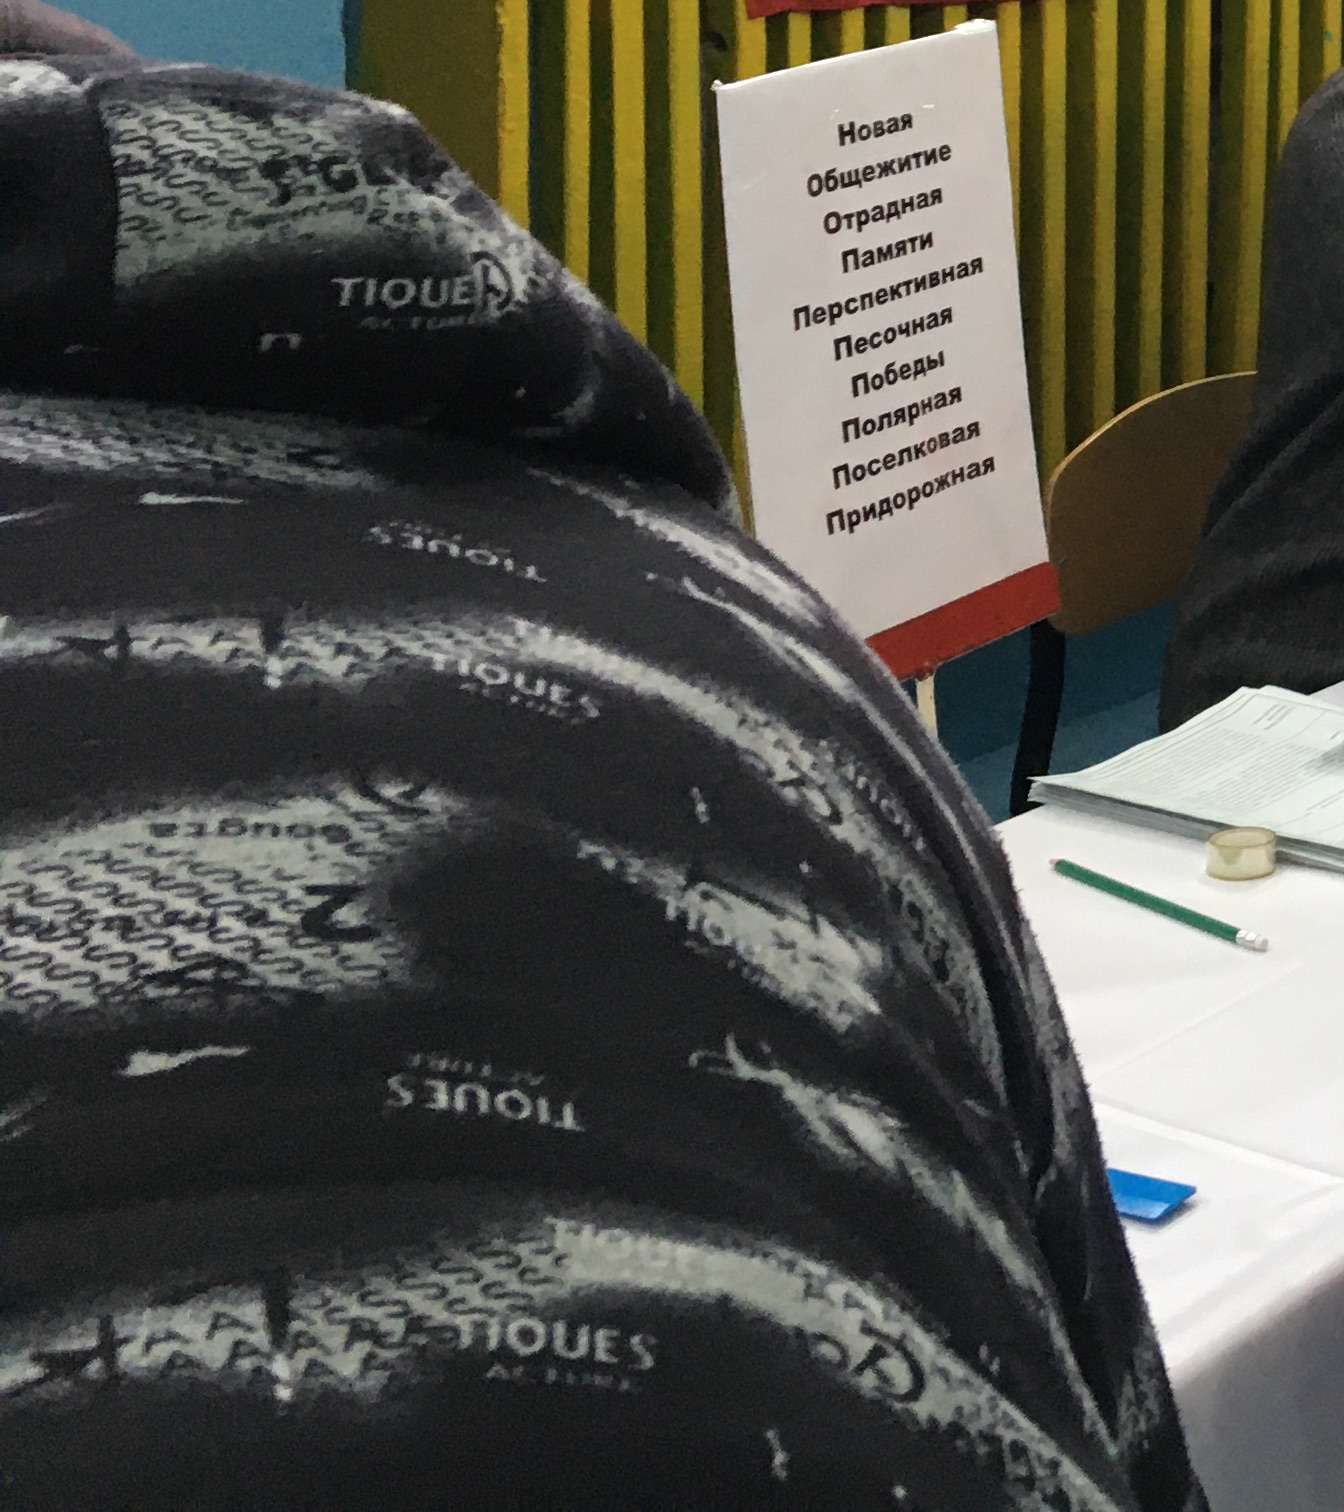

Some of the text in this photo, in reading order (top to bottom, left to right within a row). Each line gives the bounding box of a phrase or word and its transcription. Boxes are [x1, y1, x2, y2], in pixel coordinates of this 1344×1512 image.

[837, 113, 912, 146] Новая
[806, 144, 951, 197] Общежитие
[823, 187, 942, 234] Отрадная
[841, 231, 933, 273] Памяти
[793, 256, 983, 330] Перспективная
[833, 306, 952, 361] Песочная
[851, 350, 944, 397] Победы
[841, 386, 962, 443] Полярная
[832, 421, 980, 489] Поселковая
[825, 456, 995, 535] Придорожная
